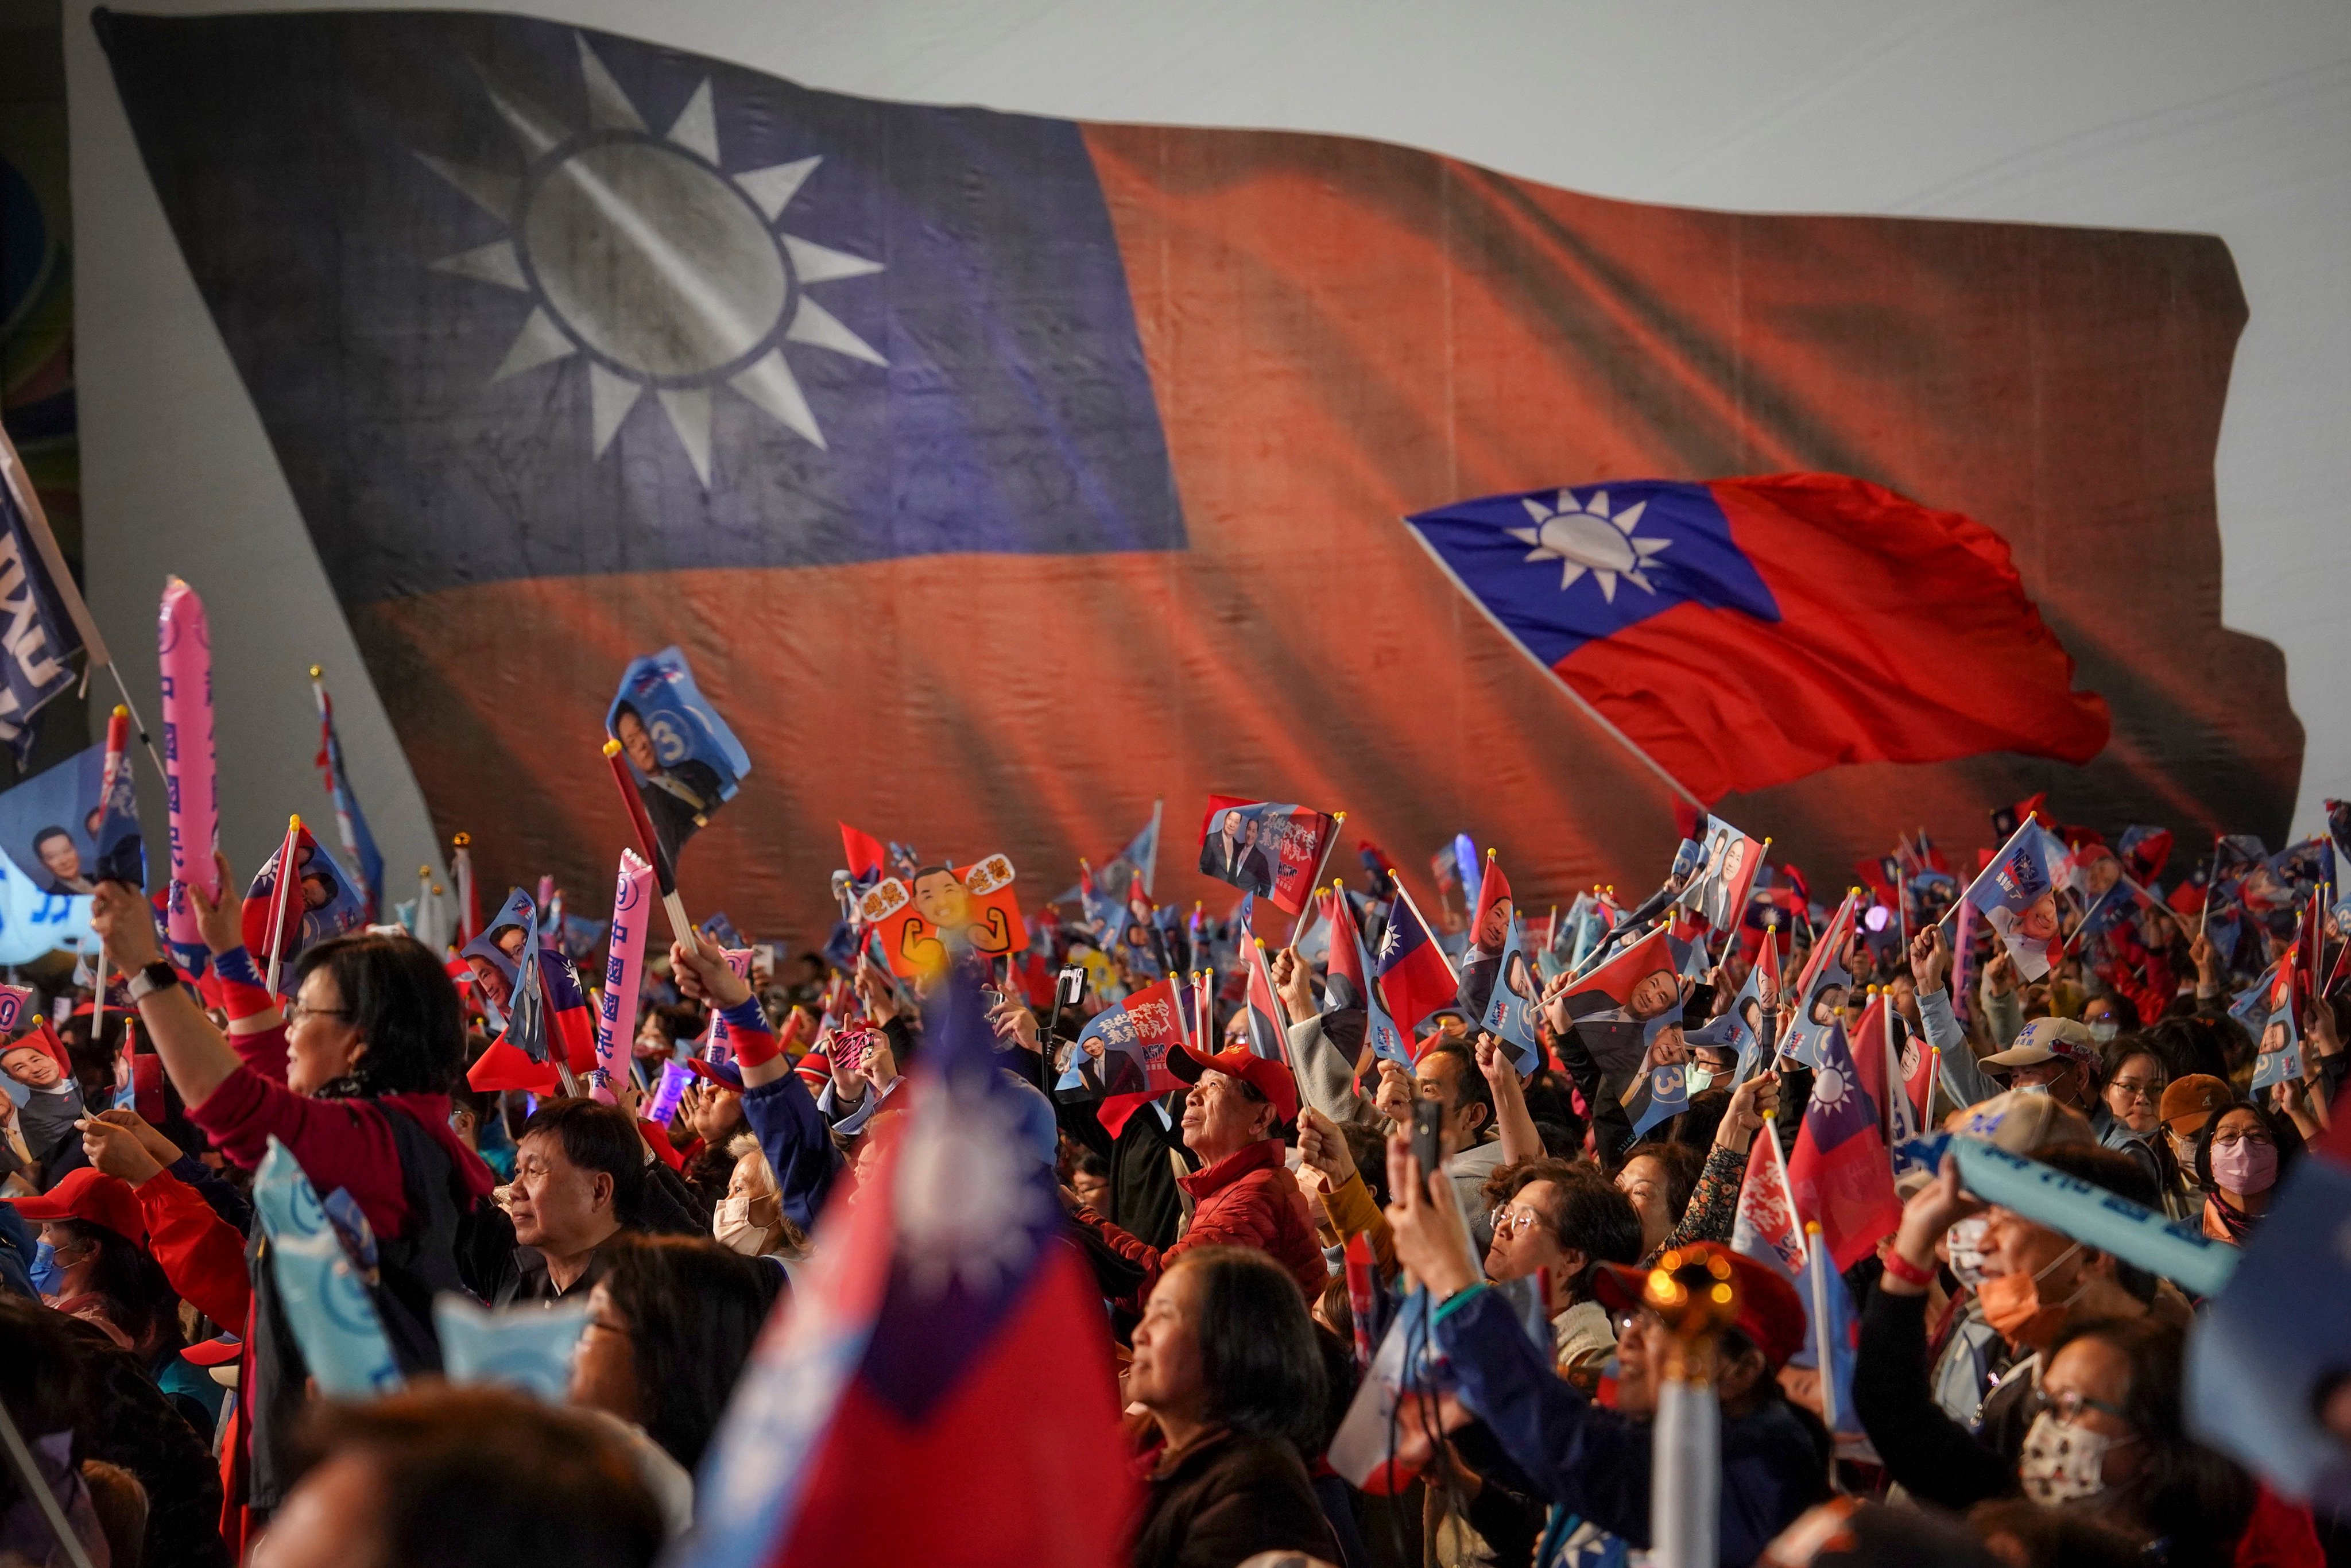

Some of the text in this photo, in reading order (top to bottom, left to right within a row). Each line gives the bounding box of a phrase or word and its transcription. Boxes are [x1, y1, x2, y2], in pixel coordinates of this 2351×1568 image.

[651, 721, 684, 761] 3
[616, 878, 627, 905] 9
[0, 1000, 16, 1026] 9
[1655, 1067, 1684, 1095] 3
